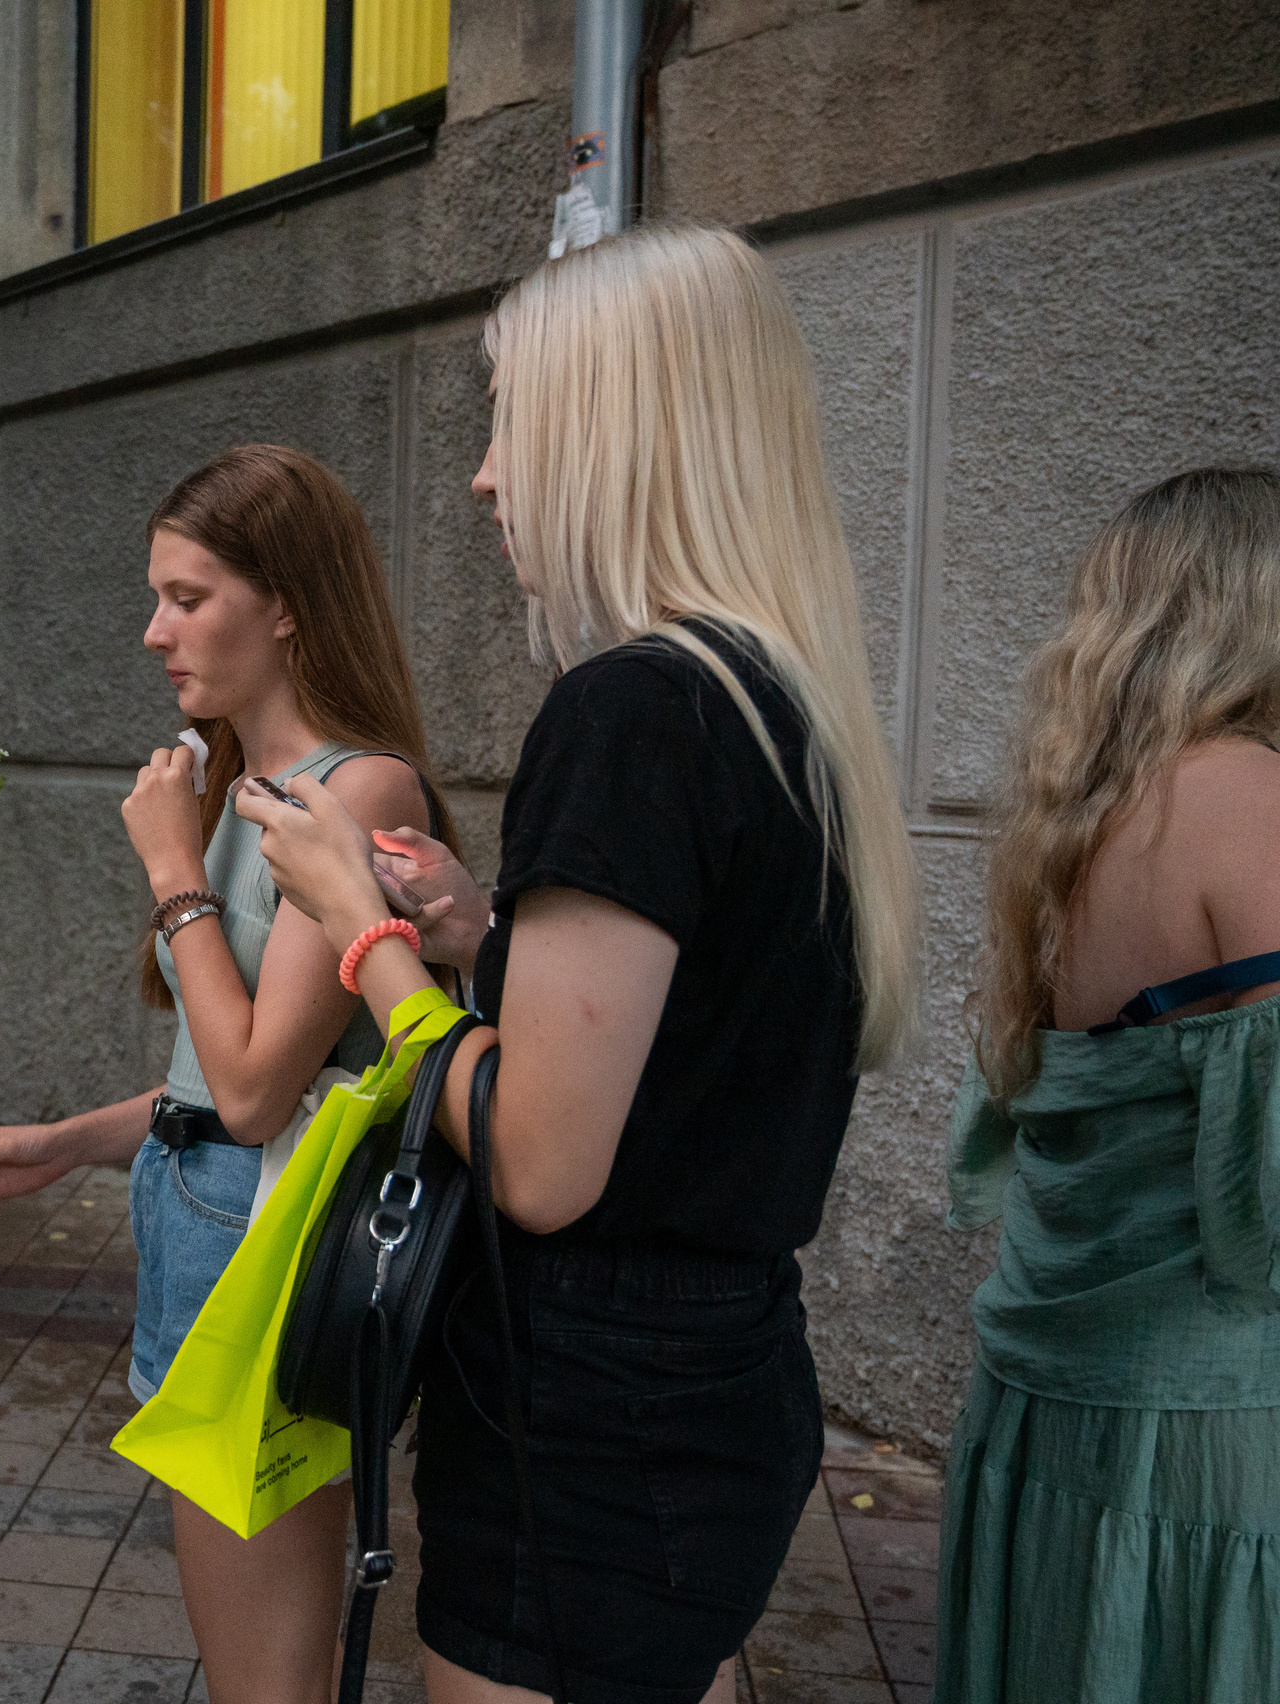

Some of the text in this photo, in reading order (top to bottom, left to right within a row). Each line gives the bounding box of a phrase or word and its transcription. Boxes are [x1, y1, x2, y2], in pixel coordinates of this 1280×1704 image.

[256, 1453, 291, 1481] Beauty favs
[256, 1455, 308, 1493] are coming home
